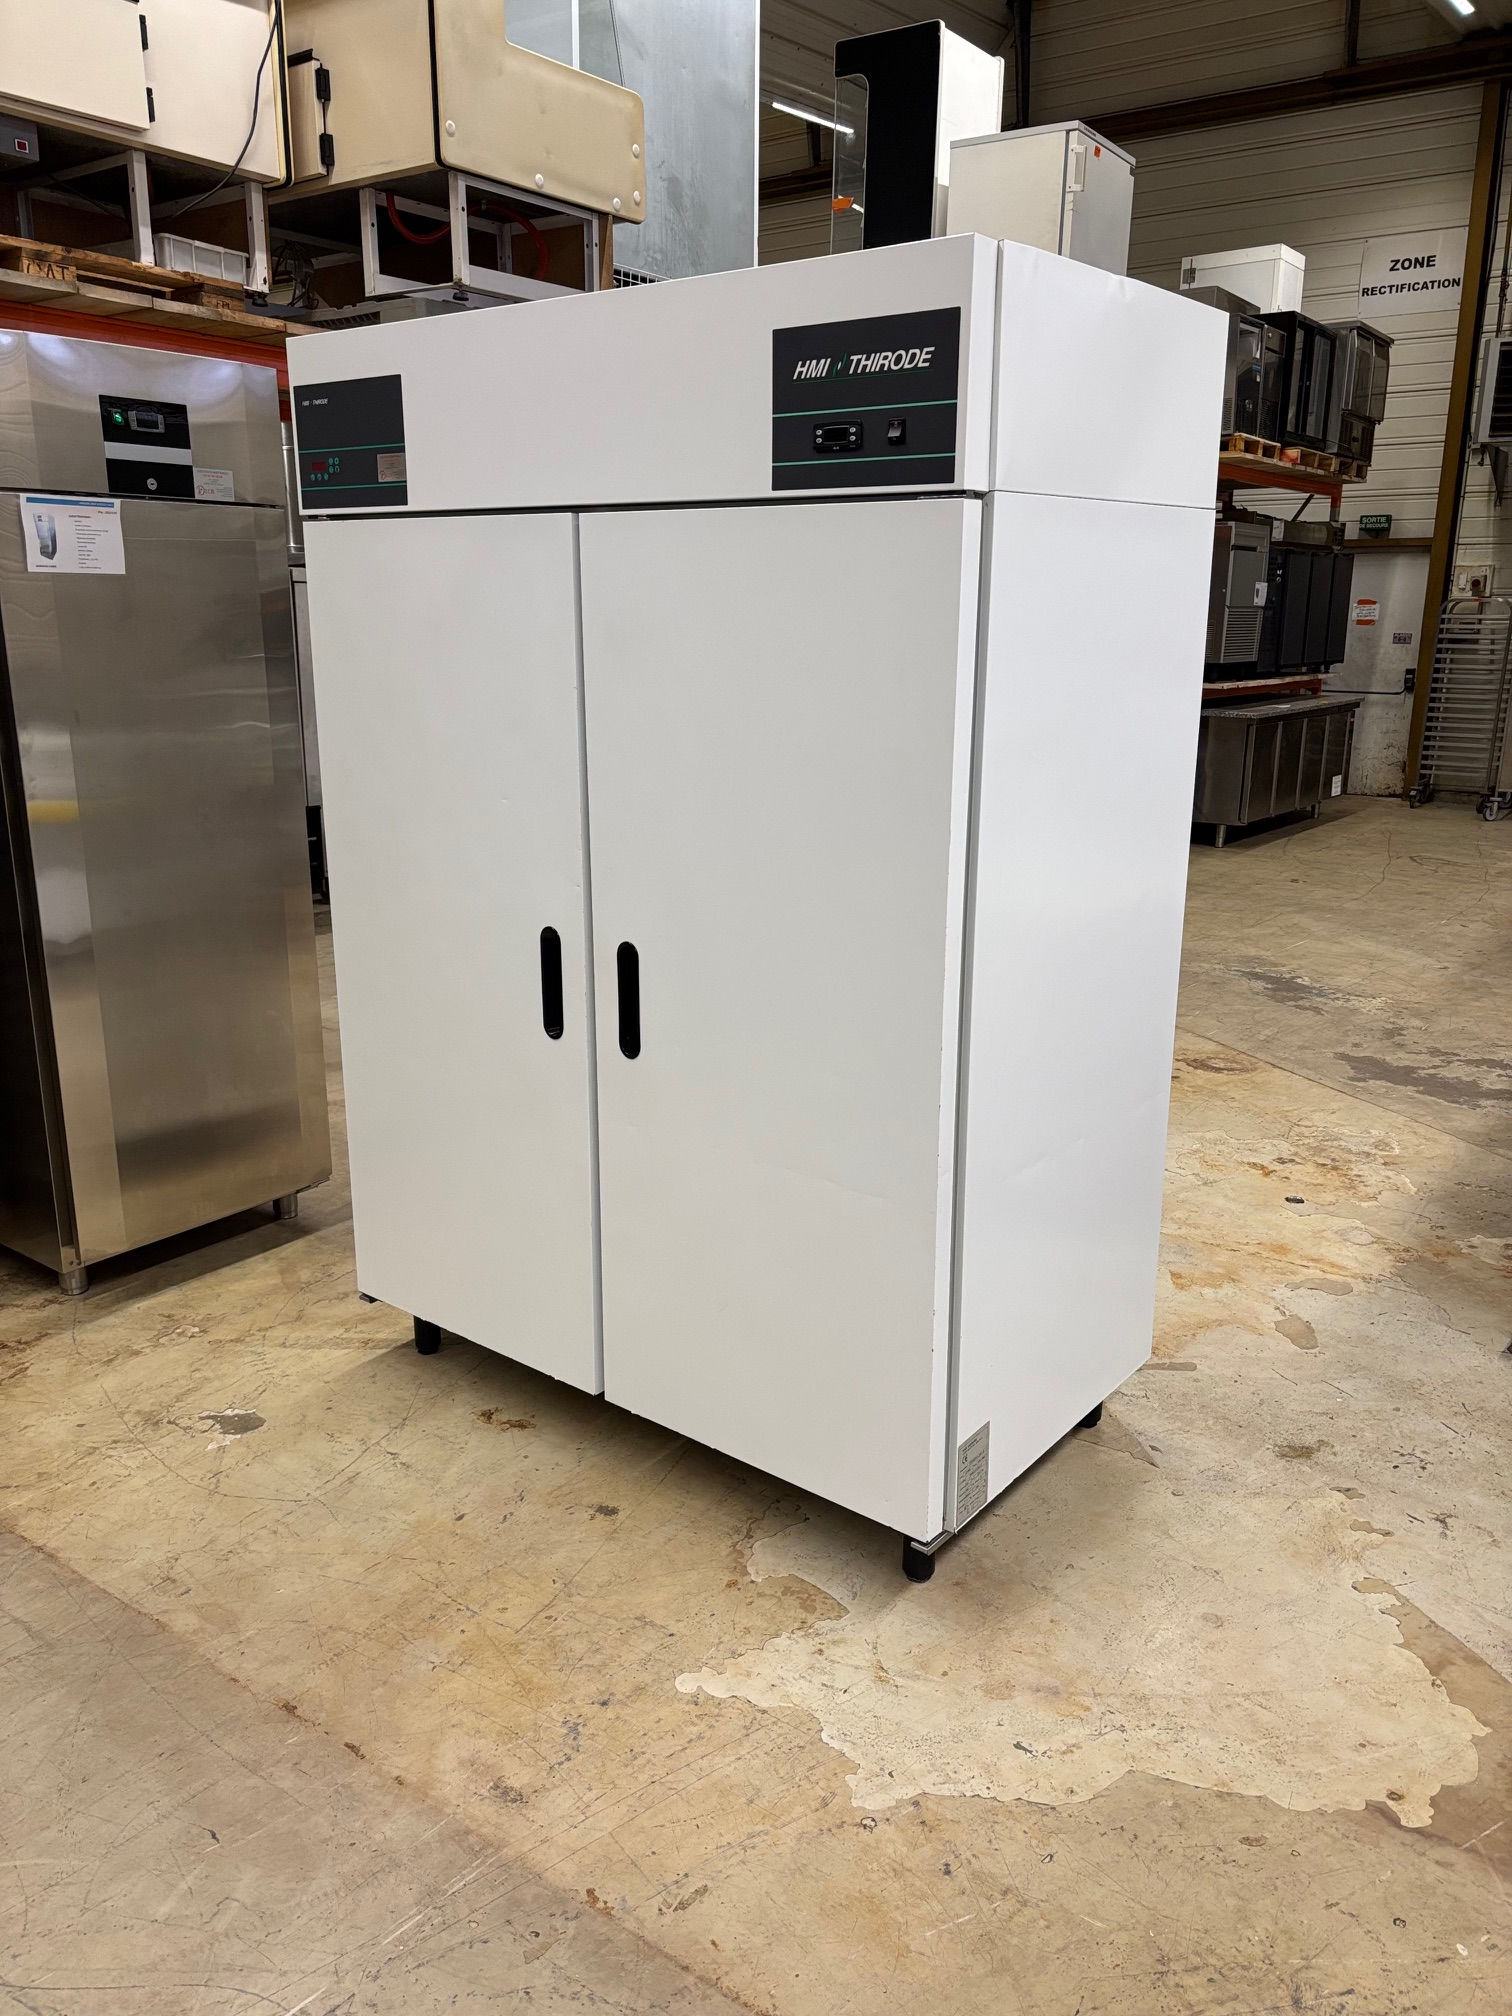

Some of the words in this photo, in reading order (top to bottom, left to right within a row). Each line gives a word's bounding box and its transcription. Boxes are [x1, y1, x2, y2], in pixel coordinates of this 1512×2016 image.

[1389, 254, 1437, 272] ZONE
[1361, 277, 1461, 297] RECTIFICATION
[793, 358, 832, 380] HMI
[848, 347, 935, 375] THIRODE
[1361, 516, 1387, 524] SORTIE
